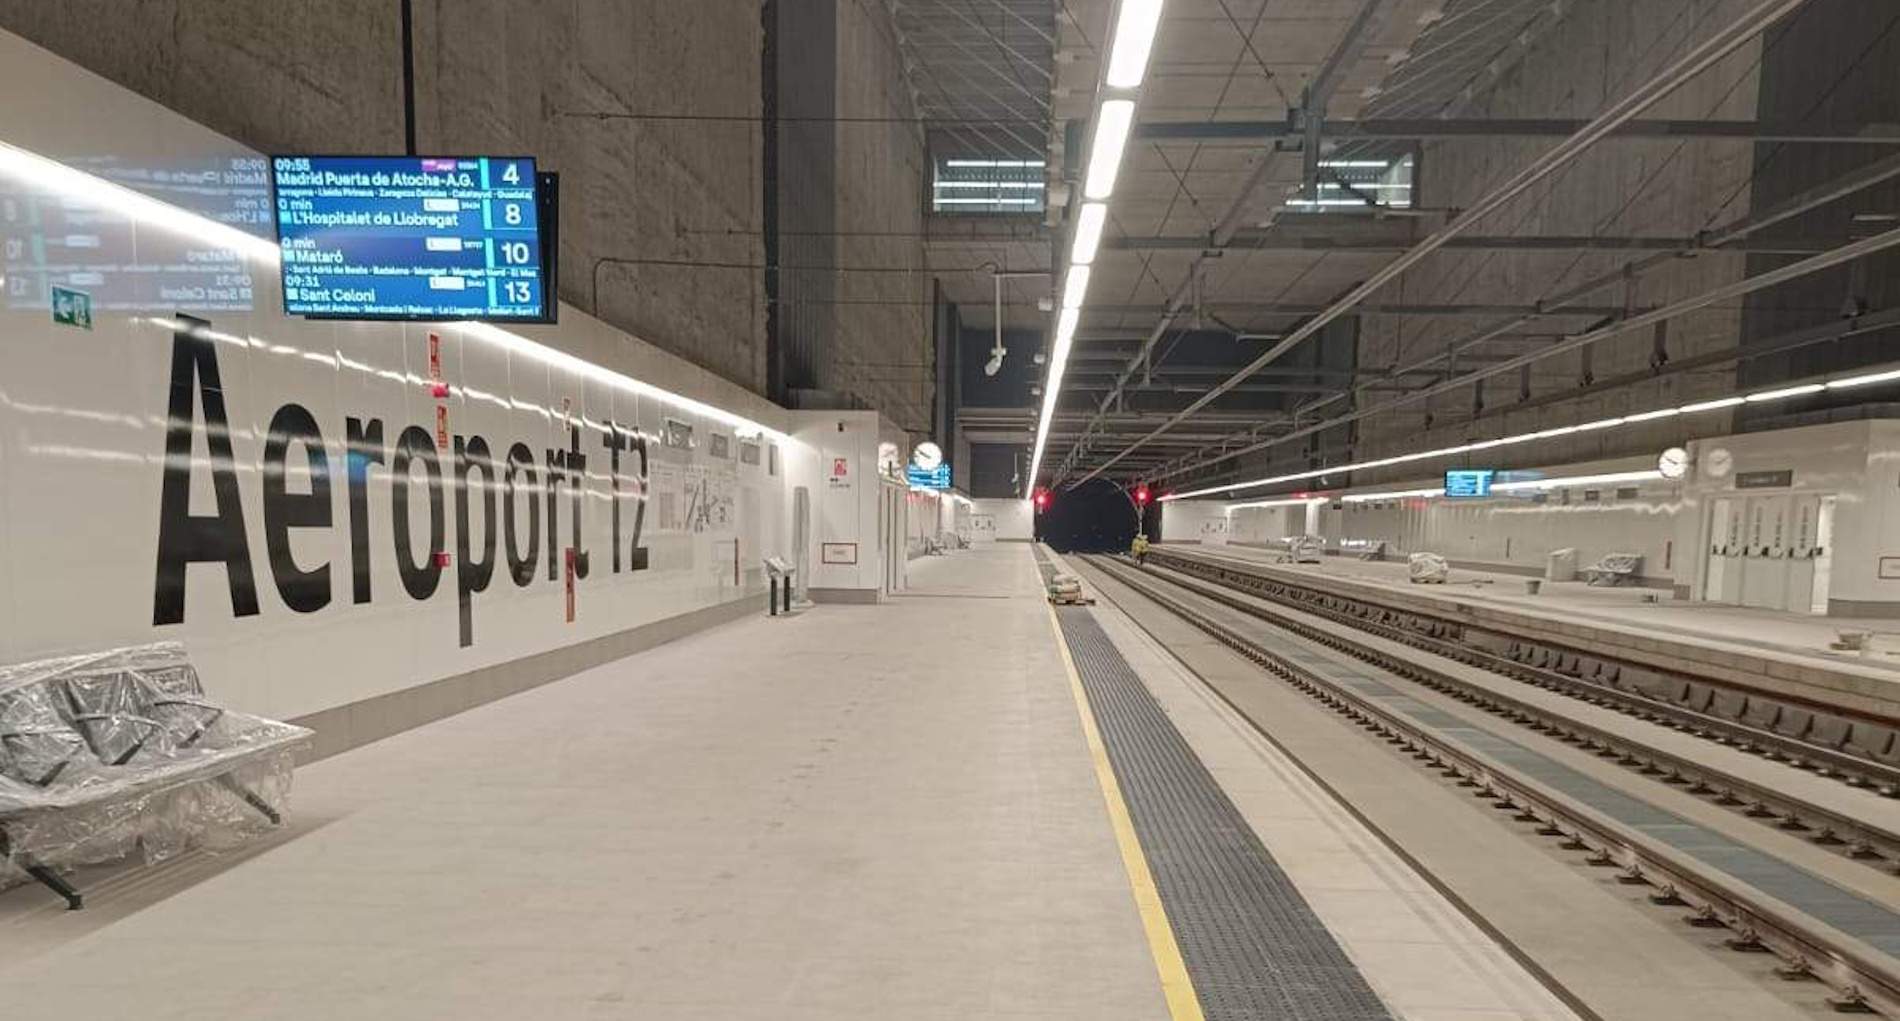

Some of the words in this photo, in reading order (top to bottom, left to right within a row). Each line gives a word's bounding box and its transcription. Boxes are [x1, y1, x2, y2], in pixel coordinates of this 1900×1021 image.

[276, 170, 324, 186] Madrid
[325, 171, 371, 187] Puerta
[372, 171, 390, 186] de
[391, 172, 475, 188] Atocha-A.G.
[502, 163, 520, 185] 4
[278, 198, 288, 210] 0
[291, 197, 313, 210] min
[292, 210, 371, 228] L'Hospitalet
[373, 211, 392, 226] de
[393, 212, 458, 229] Llobregat
[505, 203, 522, 225] 8
[281, 237, 291, 249] 0
[294, 235, 316, 249] min
[295, 248, 344, 264] Mataró
[501, 241, 529, 264] 10
[285, 275, 321, 287] 09:31
[300, 288, 331, 302] Sant
[332, 288, 376, 303] Celoni
[505, 281, 532, 303] 13
[152, 312, 589, 648] Aeroport
[602, 420, 649, 574] T2
